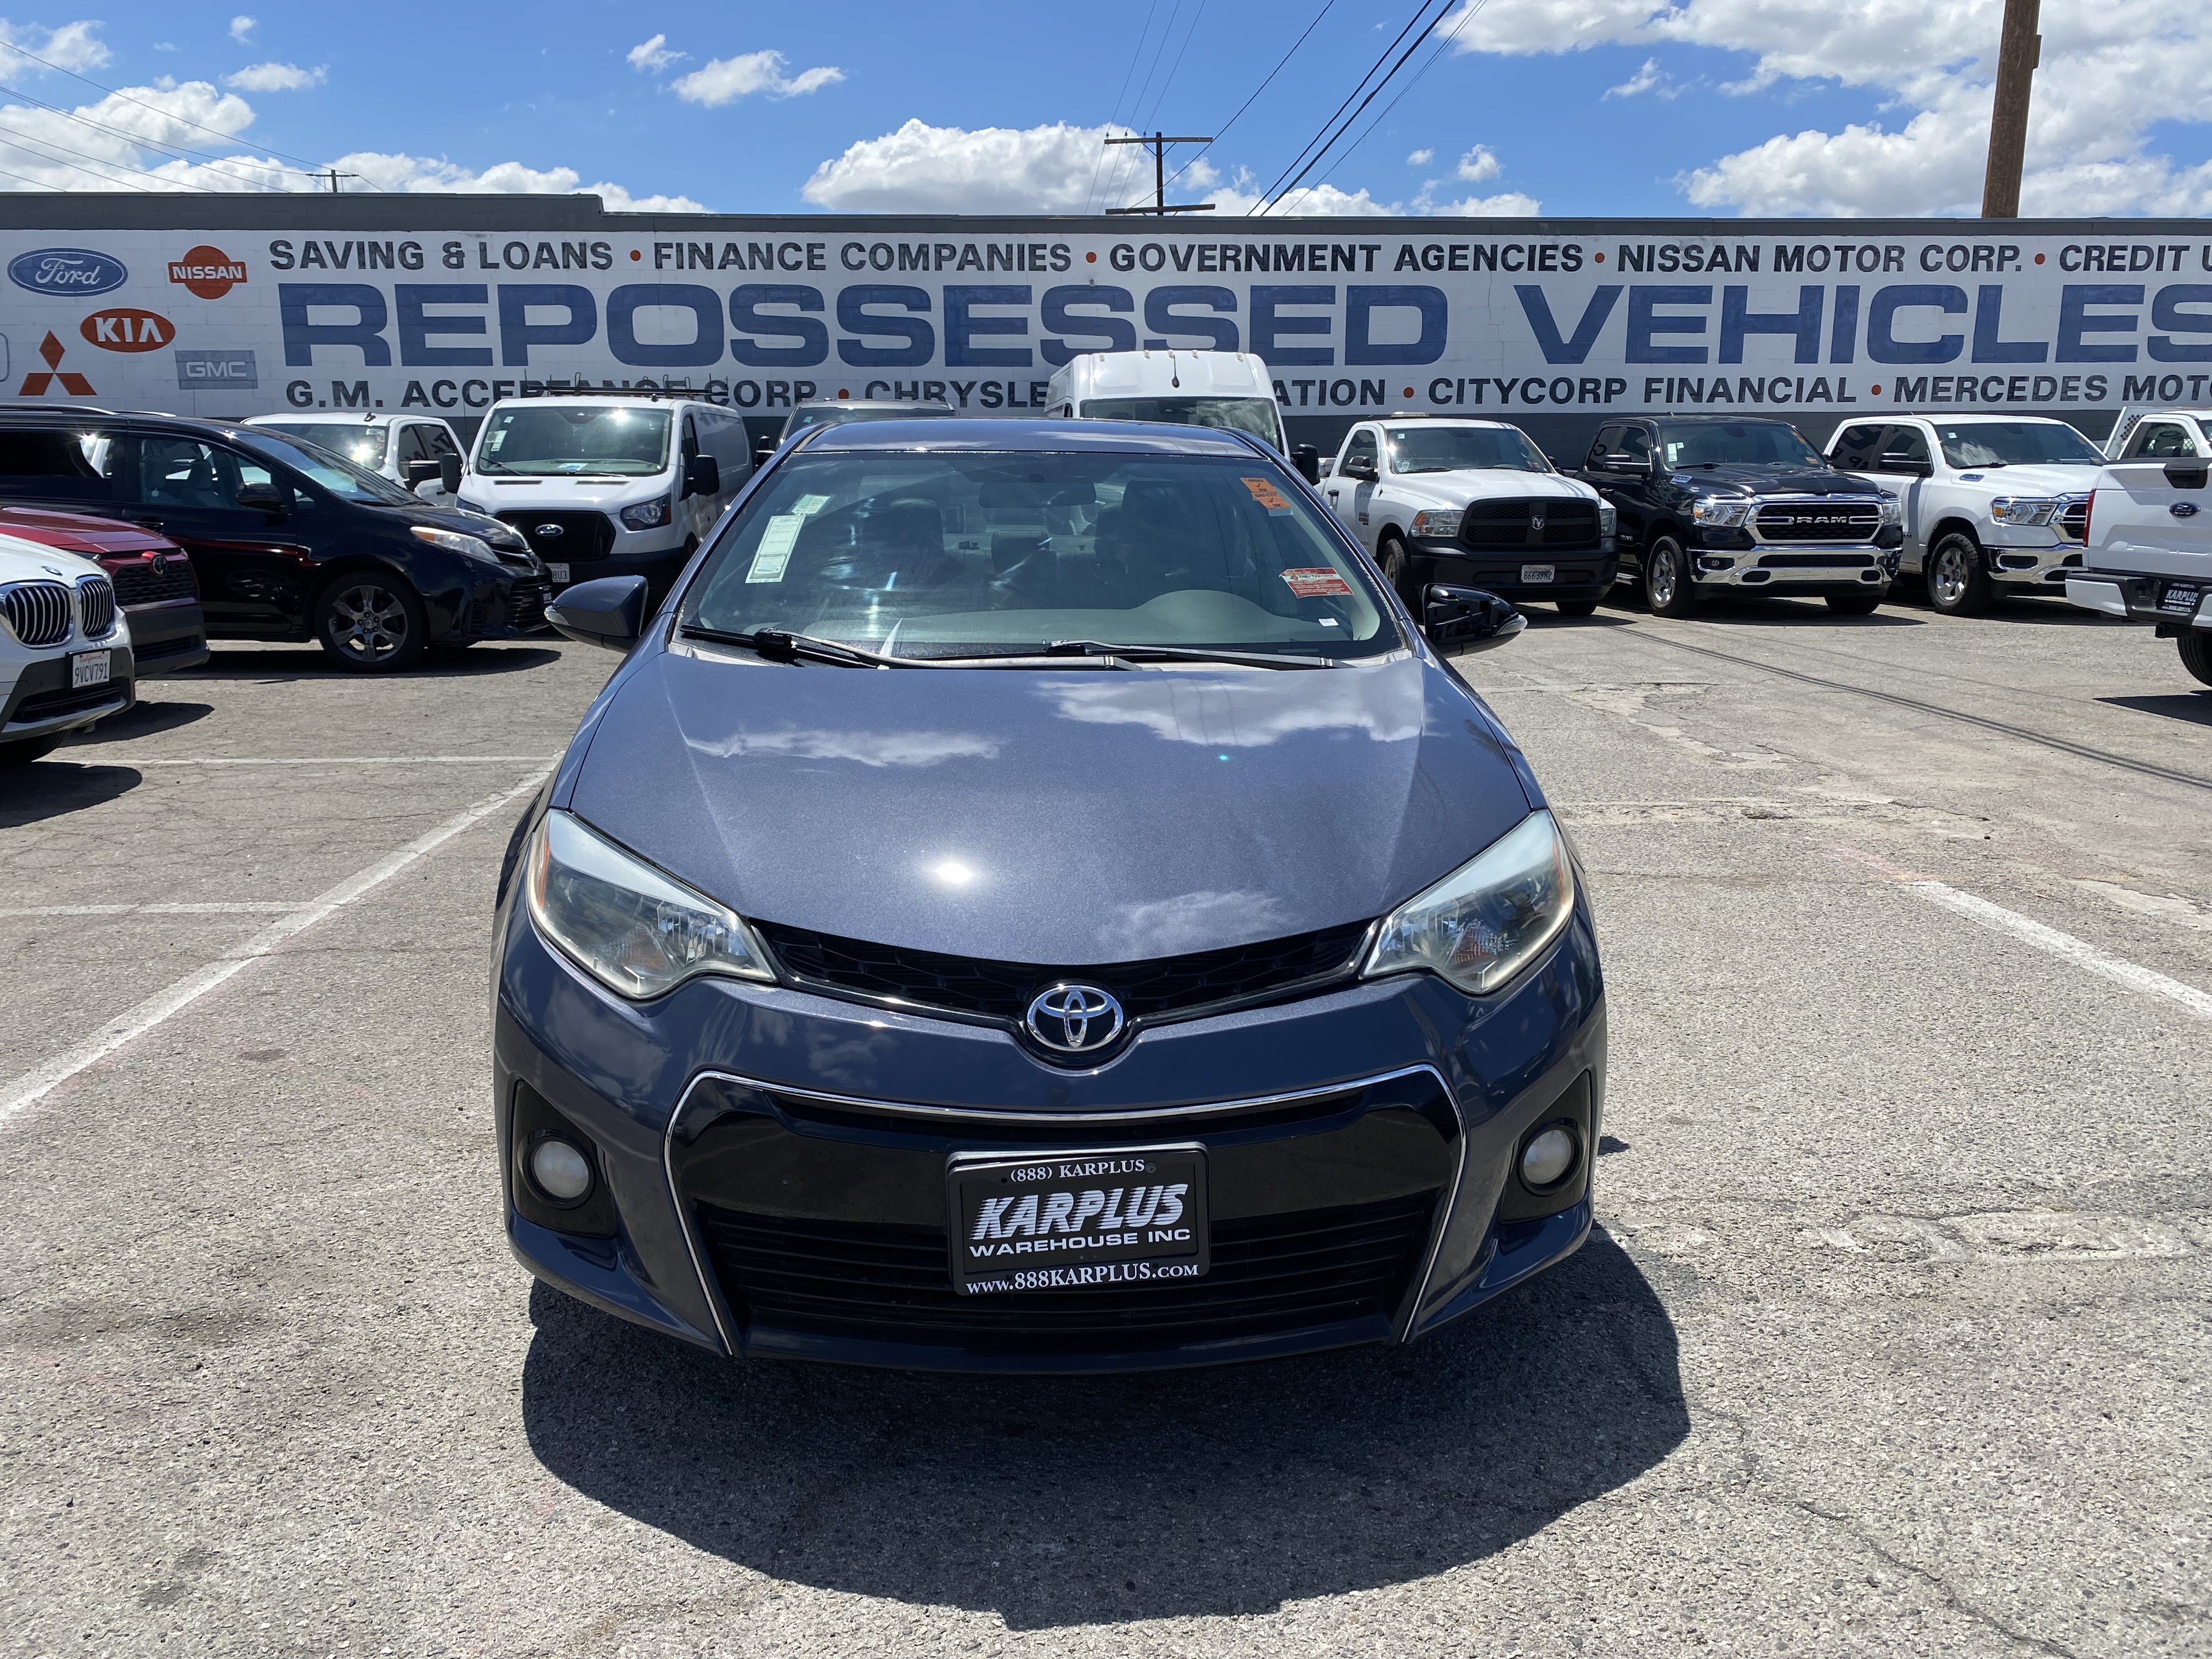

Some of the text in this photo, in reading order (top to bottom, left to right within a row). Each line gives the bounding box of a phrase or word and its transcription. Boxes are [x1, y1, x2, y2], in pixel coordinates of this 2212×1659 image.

[269, 240, 613, 270] SAVING & LOANS
[653, 242, 1071, 272] FINANCE COMPANIES
[1109, 242, 1583, 273] GOVERNMENT AGENCIES
[1617, 244, 2022, 273] NISSAN MOTOR CORP.
[2059, 244, 2191, 272] CREDIT
[35, 257, 101, 285] Ford
[172, 266, 243, 280] NISSAN
[93, 317, 164, 343] KIA
[278, 283, 2212, 367] REPOSSESSED VEHICLES
[185, 361, 247, 377] GMC
[285, 380, 816, 408] G.M. ACCEPT CORP
[865, 380, 1049, 408] CHRYSLE
[1427, 376, 1857, 404] CITYCORP FINANCIAL
[1893, 374, 2212, 403] MERCEDES MOT
[75, 662, 108, 685] 9VCV791
[1010, 1159, 1144, 1182] (888) KARPLUS
[969, 1183, 1189, 1240] KARPLUS
[969, 1228, 1191, 1257] WAREHOUSE INC
